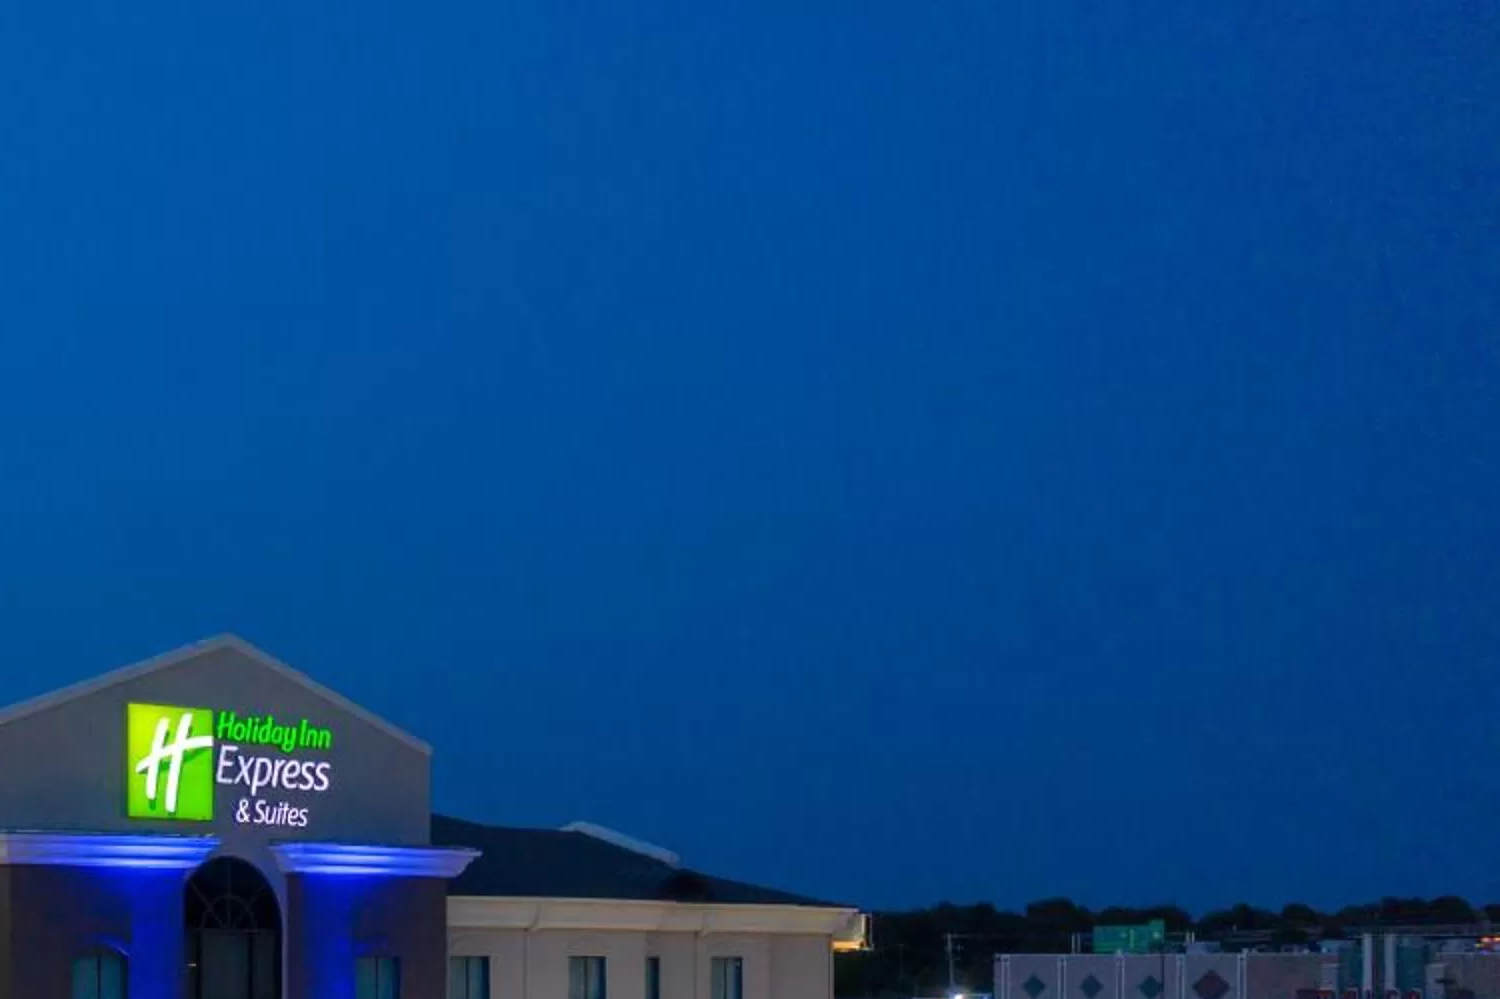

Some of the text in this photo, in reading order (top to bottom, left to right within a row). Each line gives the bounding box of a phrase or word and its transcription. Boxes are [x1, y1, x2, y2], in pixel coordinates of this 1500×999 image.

[217, 711, 331, 752] Holiday Inn
[216, 744, 330, 796] Express
[235, 798, 308, 827] & Suites
